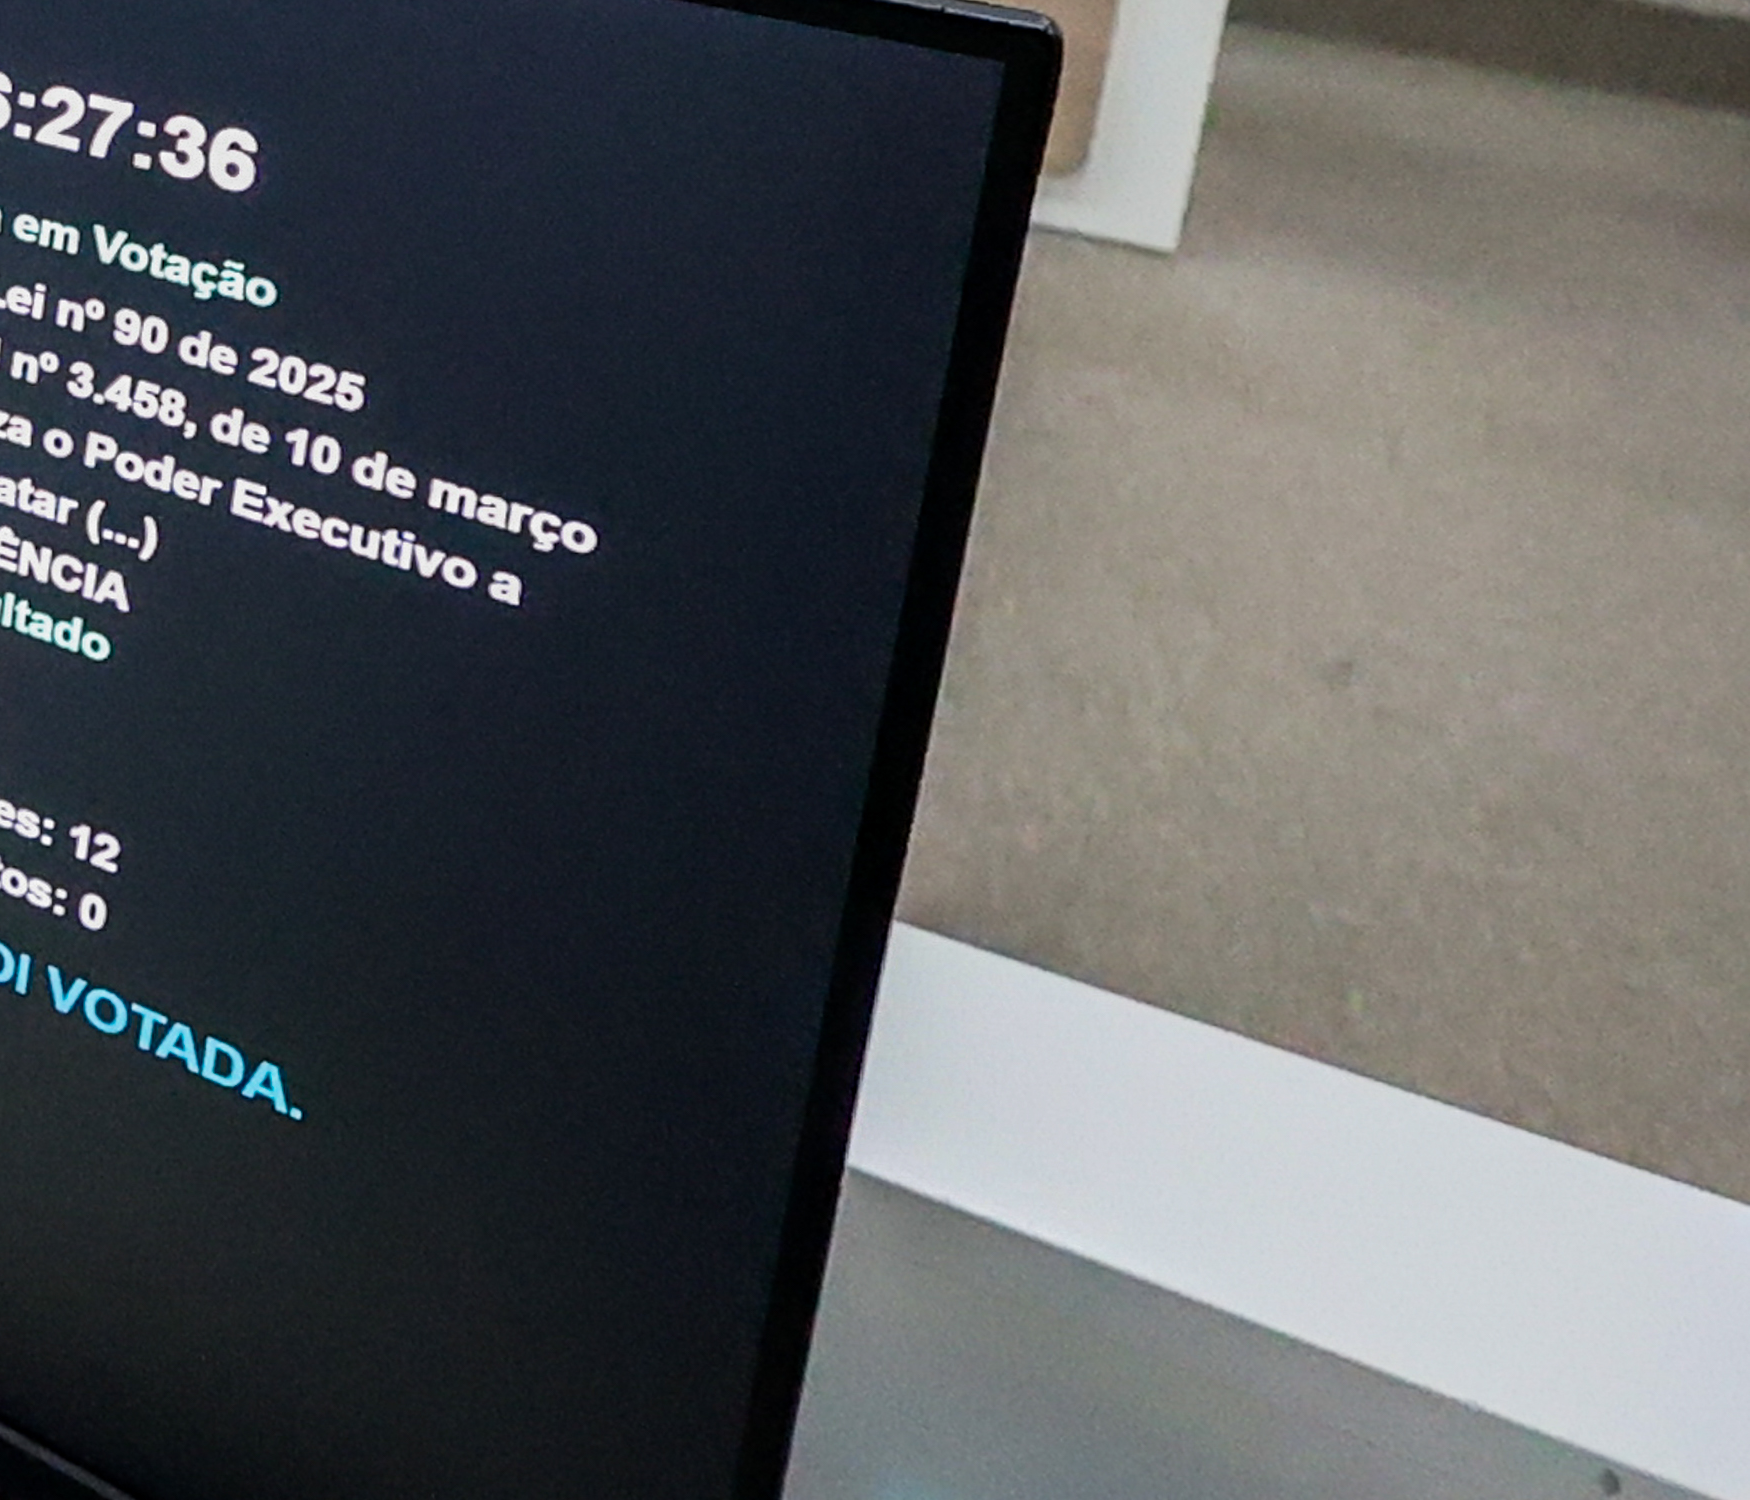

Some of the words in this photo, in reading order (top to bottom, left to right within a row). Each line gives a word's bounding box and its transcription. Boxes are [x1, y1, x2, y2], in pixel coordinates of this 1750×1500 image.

[13, 214, 79, 254] em
[94, 224, 277, 307] Votação
[56, 299, 105, 332] nº
[113, 308, 168, 353] 90
[178, 331, 238, 375] de
[248, 348, 365, 411] 2025
[11, 351, 59, 383] nº
[67, 361, 196, 439] 3.458,
[210, 408, 270, 453] de
[285, 428, 341, 474] 10
[352, 452, 416, 498] de
[428, 479, 597, 553] março
[43, 429, 73, 458] o
[84, 432, 223, 505] Poder
[230, 478, 477, 588] Executivo
[488, 572, 521, 605] a
[87, 500, 157, 561] (...)
[70, 825, 120, 873] 12
[79, 893, 106, 930] 0
[48, 965, 302, 1120] VOTADA.
